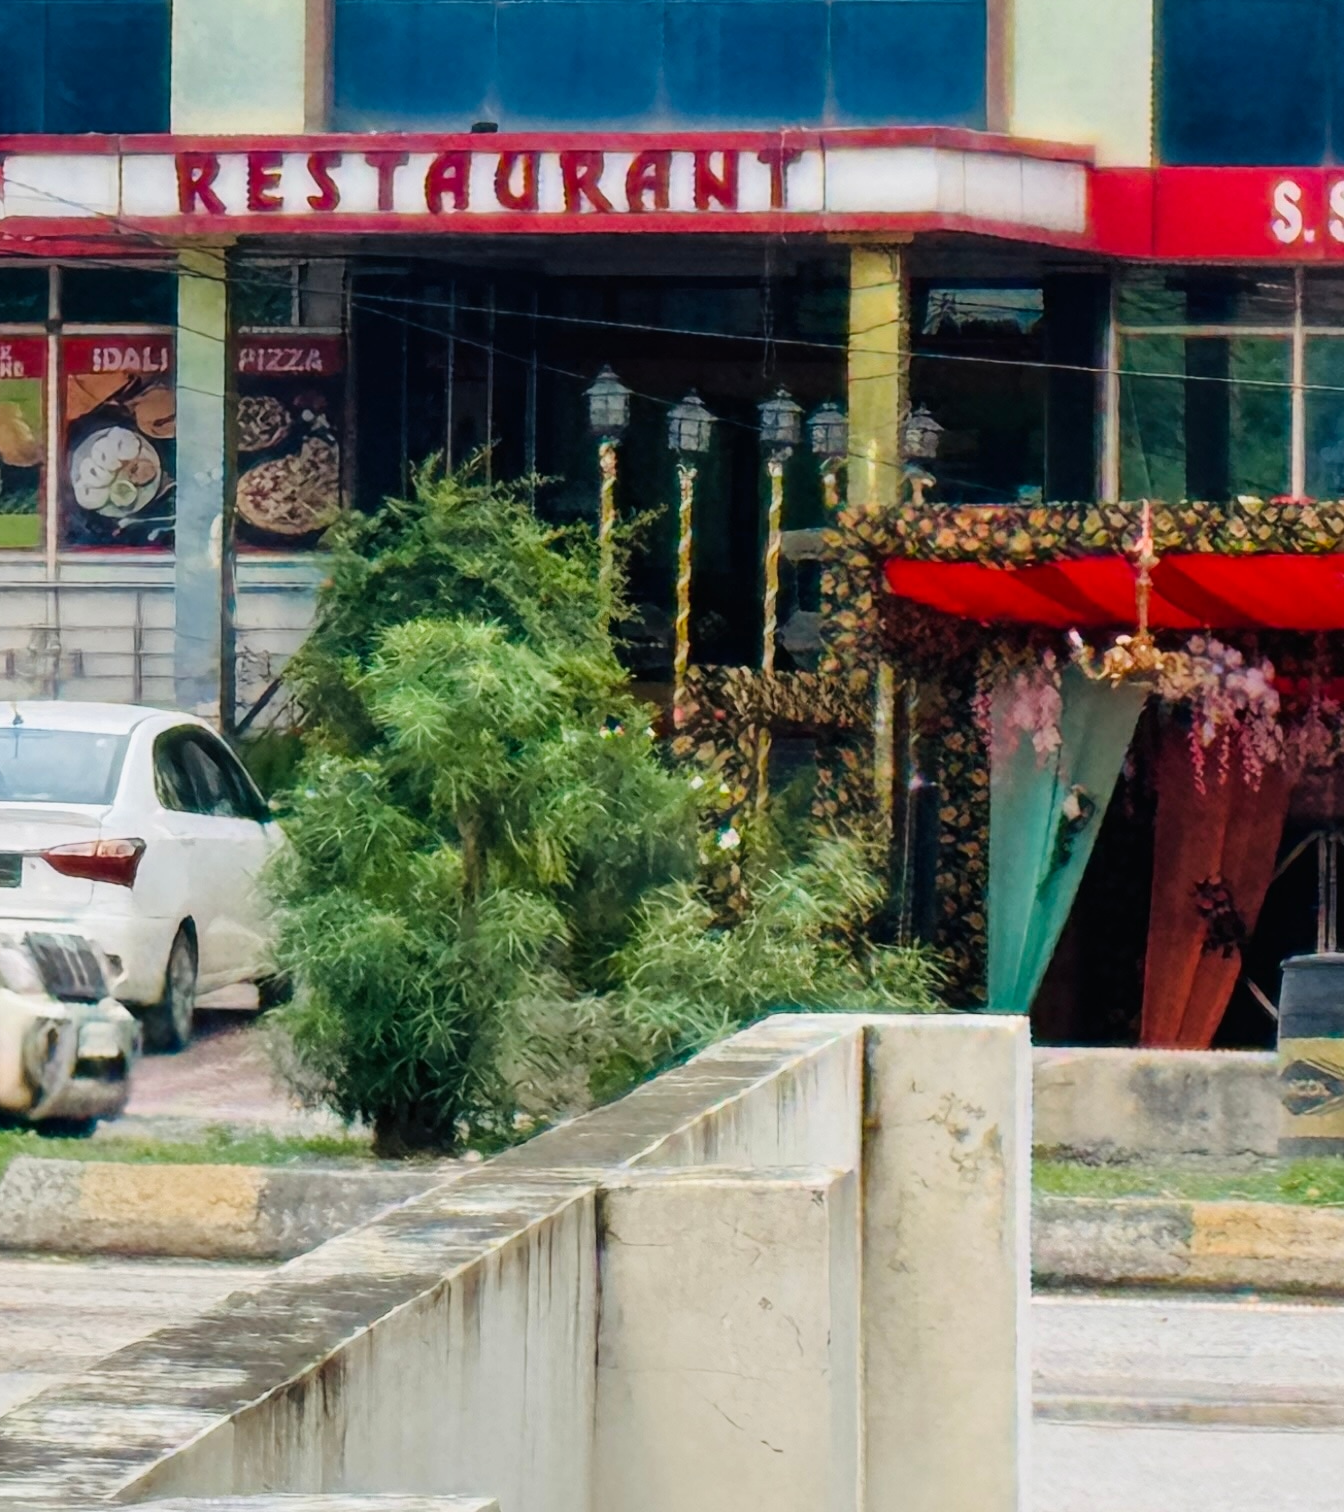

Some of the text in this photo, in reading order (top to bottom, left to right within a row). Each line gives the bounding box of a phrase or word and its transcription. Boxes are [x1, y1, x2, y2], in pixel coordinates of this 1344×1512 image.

[175, 149, 803, 214] RESTAURANT
[92, 347, 168, 372] IDALI
[237, 348, 324, 372] PIZZA
